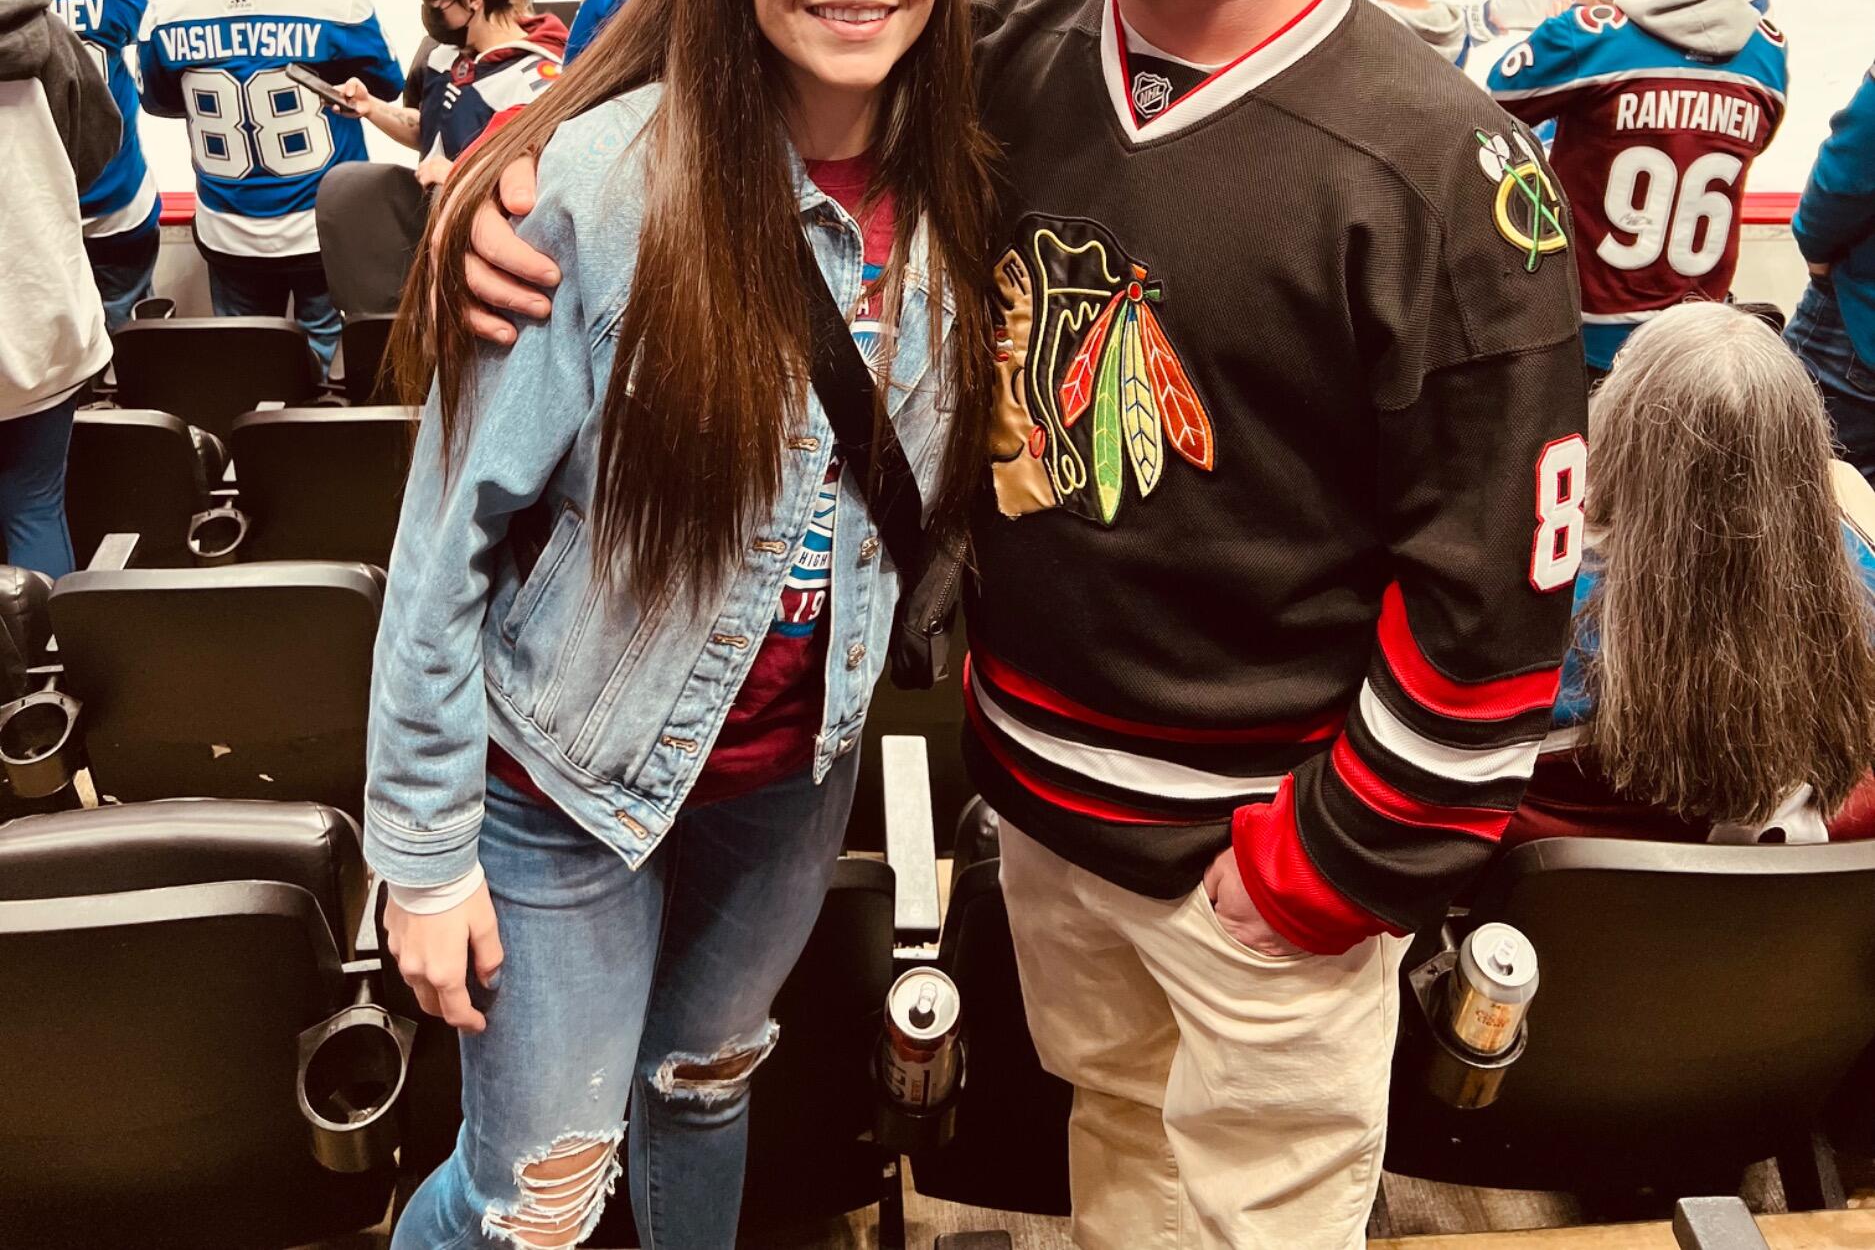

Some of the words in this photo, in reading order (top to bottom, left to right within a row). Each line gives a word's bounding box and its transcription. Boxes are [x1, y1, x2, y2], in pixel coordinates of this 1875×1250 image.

[159, 21, 322, 62] VASILEVSKIY
[181, 67, 336, 180] 88
[1616, 90, 1760, 143] RANTANEN
[1596, 145, 1743, 277] 96
